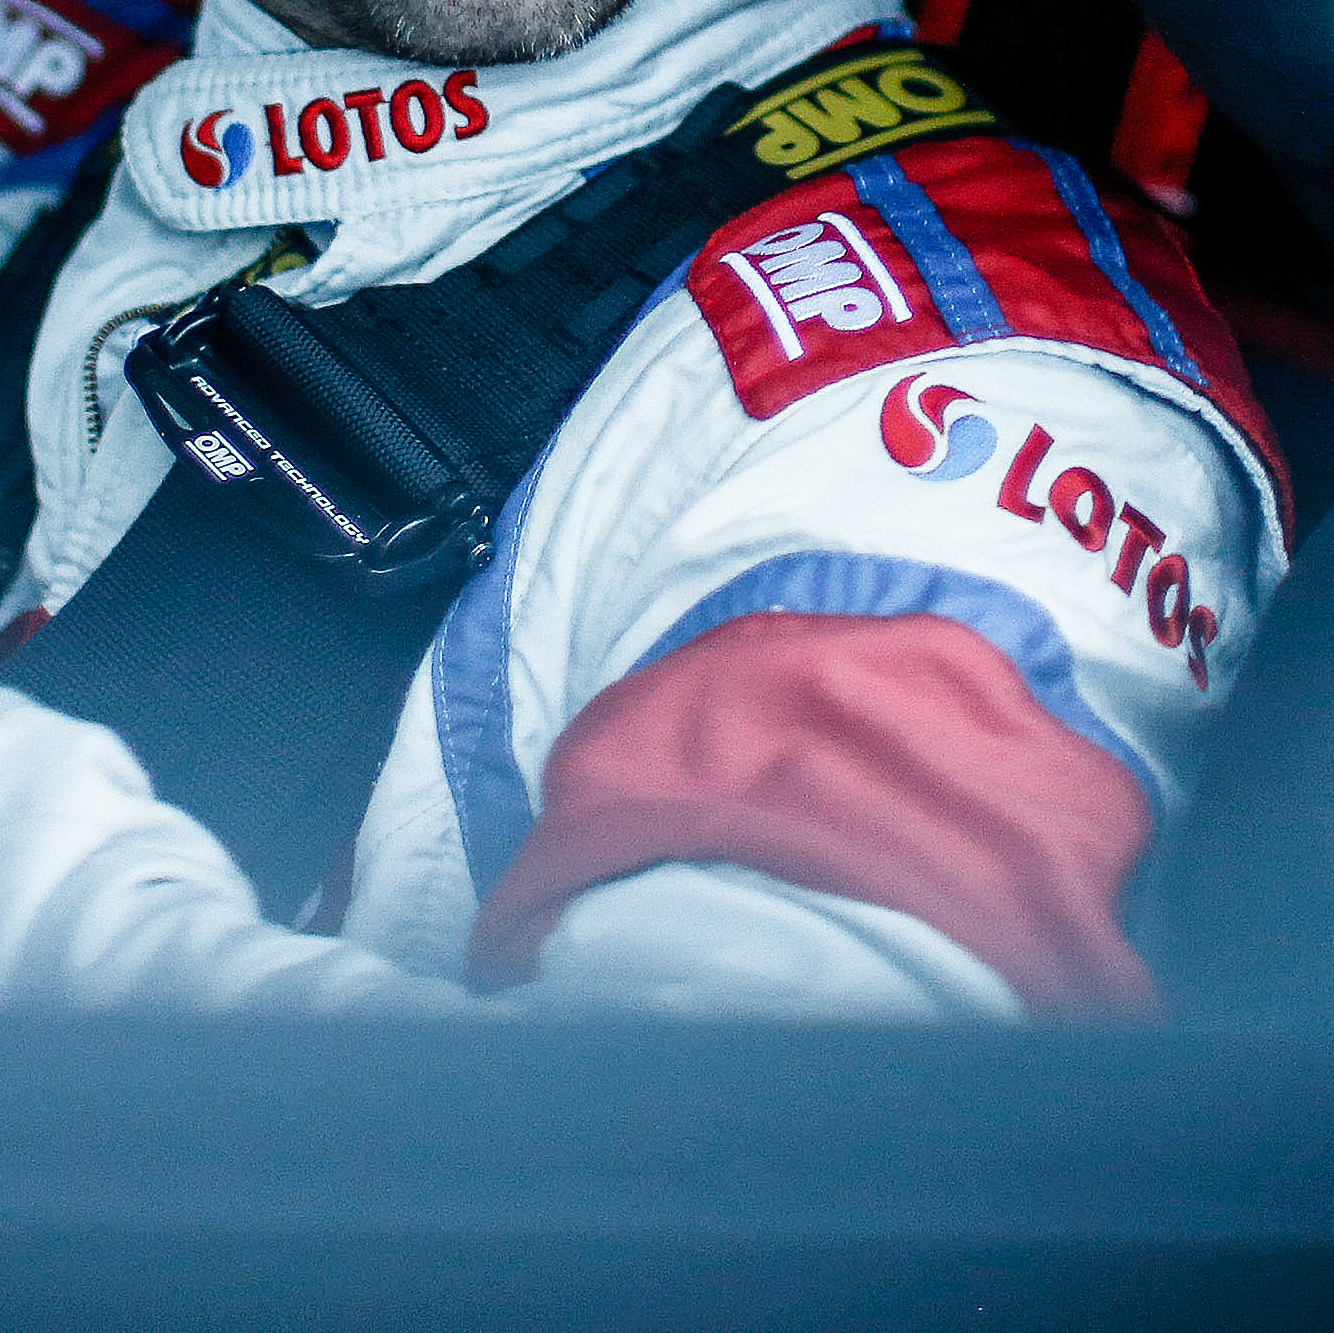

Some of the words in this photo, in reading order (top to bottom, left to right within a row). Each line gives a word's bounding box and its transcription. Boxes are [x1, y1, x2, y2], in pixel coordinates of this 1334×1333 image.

[264, 69, 490, 176] LOTOS
[753, 63, 969, 167] OMP
[739, 221, 884, 333] OMP
[189, 375, 273, 451] ADVANCED
[269, 450, 371, 545] TECHNOLOGY
[193, 434, 247, 476] OMP
[996, 422, 1219, 693] LOTOS
